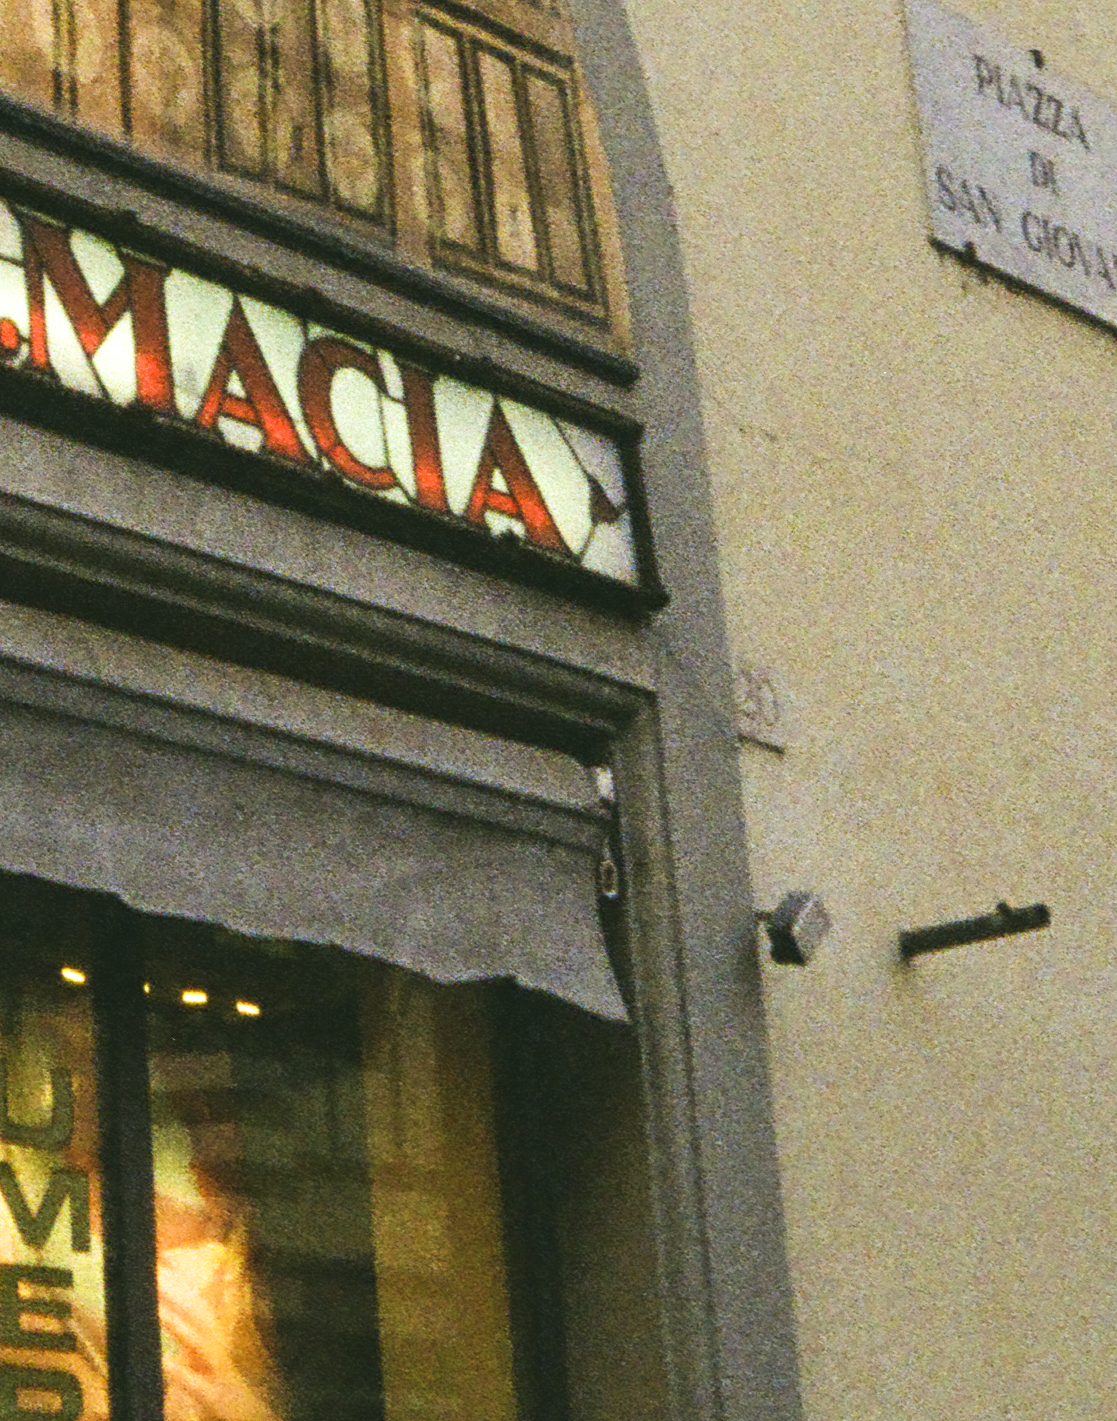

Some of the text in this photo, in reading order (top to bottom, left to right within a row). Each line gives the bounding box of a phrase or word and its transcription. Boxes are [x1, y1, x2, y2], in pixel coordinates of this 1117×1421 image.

[973, 53, 1092, 151] PIAZZA
[935, 165, 1117, 290] SAN GIOVA
